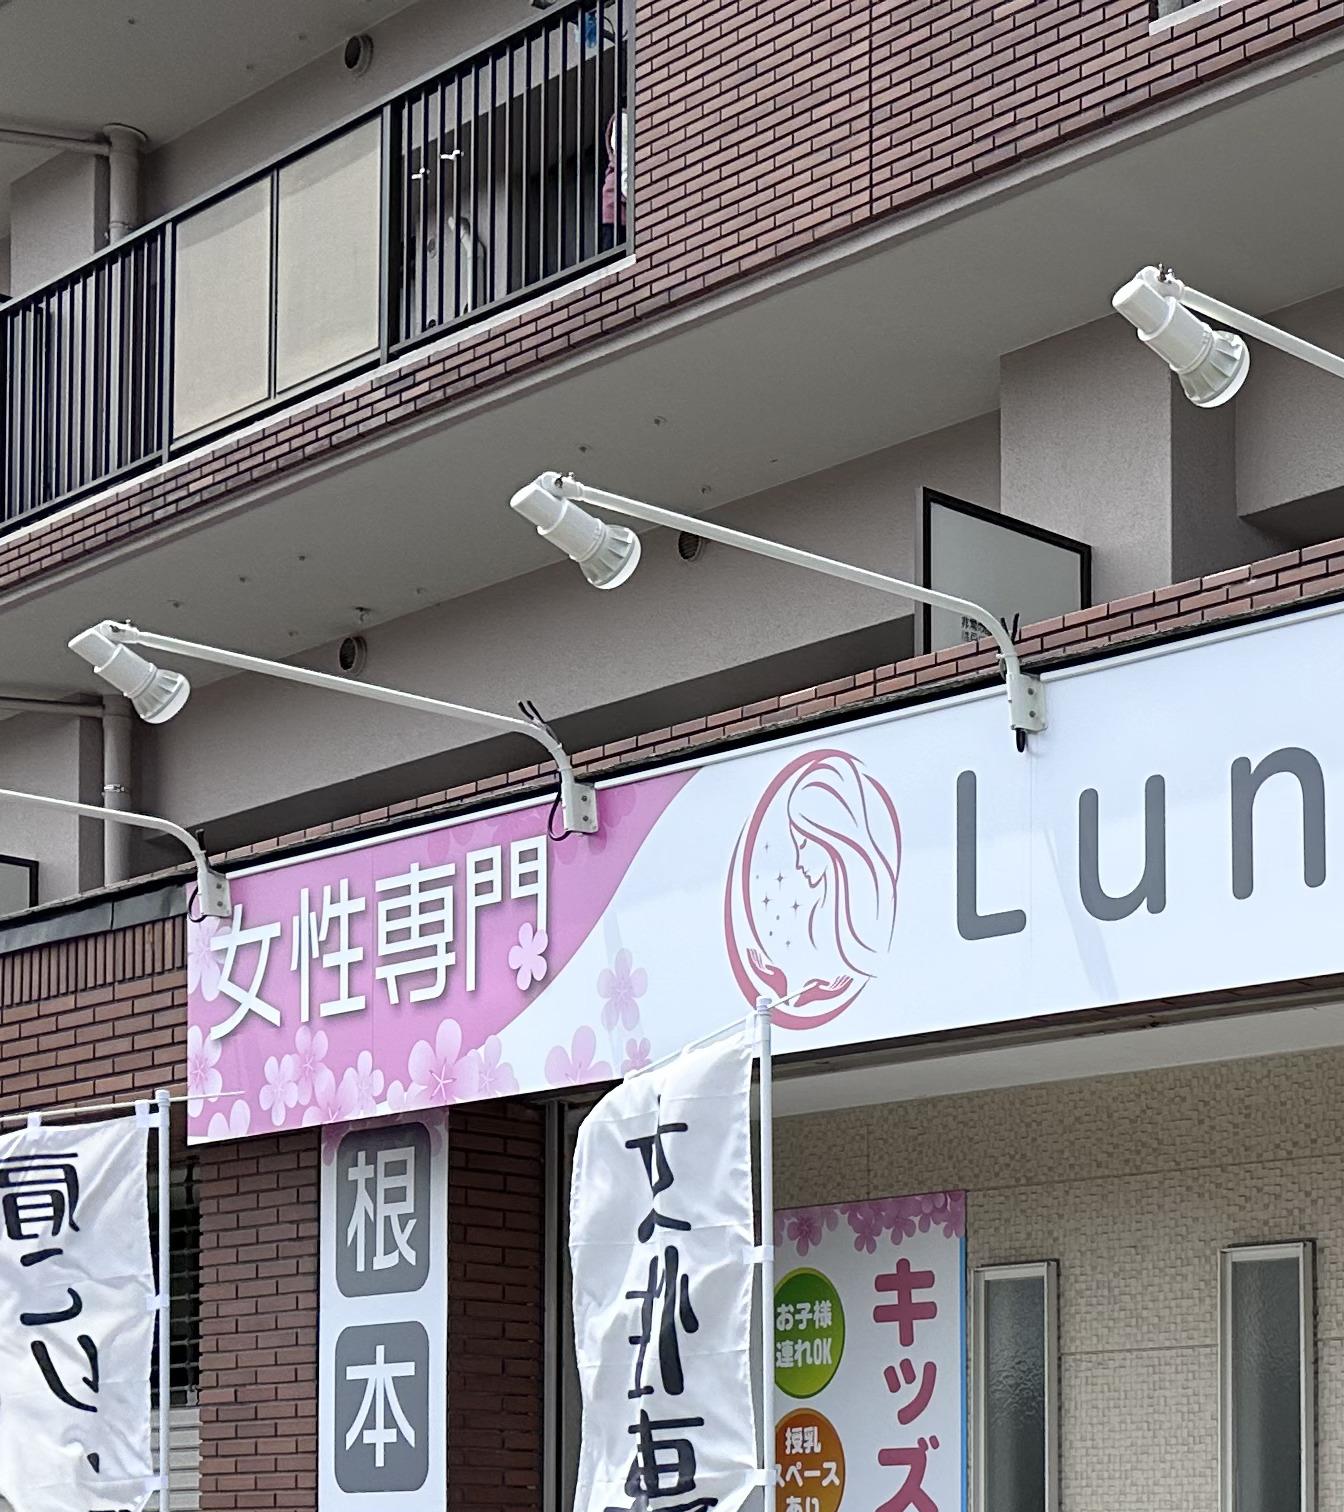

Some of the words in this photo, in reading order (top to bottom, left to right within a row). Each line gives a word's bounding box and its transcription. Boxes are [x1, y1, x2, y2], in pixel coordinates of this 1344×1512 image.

[210, 834, 549, 1041] 女性専門
[776, 1300, 832, 1331] お子様
[775, 1338, 832, 1369] 連れOK
[785, 1427, 822, 1454] 授乳
